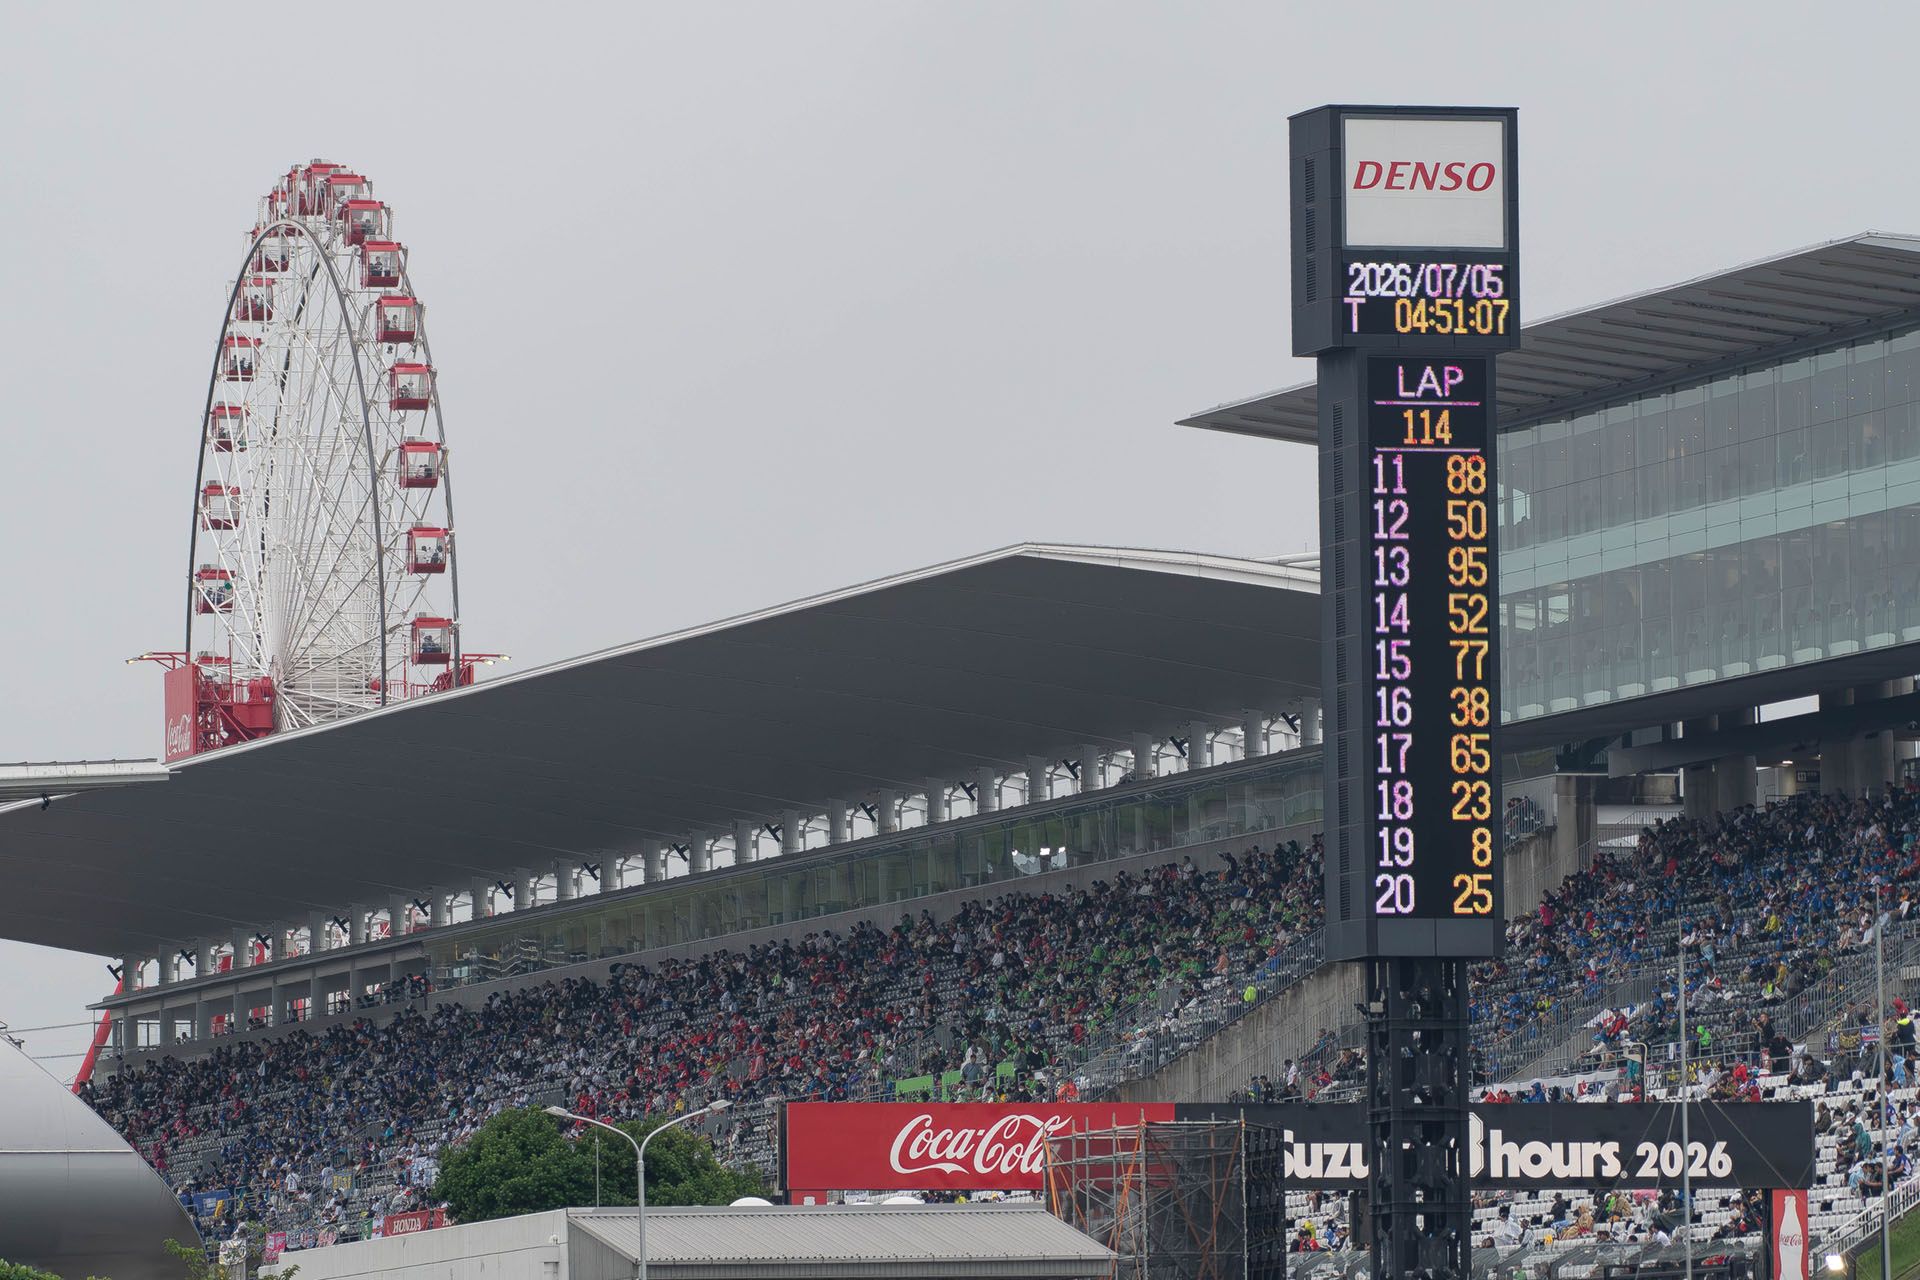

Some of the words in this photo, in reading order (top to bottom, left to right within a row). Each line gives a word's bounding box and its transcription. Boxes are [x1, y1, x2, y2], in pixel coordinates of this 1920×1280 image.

[1353, 161, 1495, 192] DENSO
[1348, 263, 1504, 298] 2026/07/05
[1343, 298, 1366, 333] T
[1395, 299, 1509, 334] 04:51:07
[1398, 366, 1464, 398] LAP
[1403, 409, 1453, 445] 114
[1373, 454, 1407, 494] 11
[1447, 455, 1486, 494] 88
[1374, 499, 1409, 539] 12
[1448, 500, 1487, 540] 50
[1374, 546, 1410, 586] 13
[1448, 547, 1487, 587] 95
[1375, 592, 1410, 633] 14
[1449, 593, 1488, 634] 52
[1376, 639, 1411, 680] 15
[1450, 640, 1489, 681] 77
[1376, 686, 1412, 727] 16
[1450, 687, 1490, 727] 38
[1377, 733, 1413, 774] 17
[1451, 733, 1490, 774] 65
[1378, 780, 1414, 820] 18
[1452, 780, 1491, 820] 23
[1379, 827, 1415, 867] 19
[1472, 827, 1492, 867] 8
[1375, 873, 1415, 914] 20
[1453, 873, 1493, 914] 25
[1490, 1129, 1622, 1179] hours
[1636, 1141, 1732, 1178] 2026
[392, 1217, 421, 1234] HONDA
